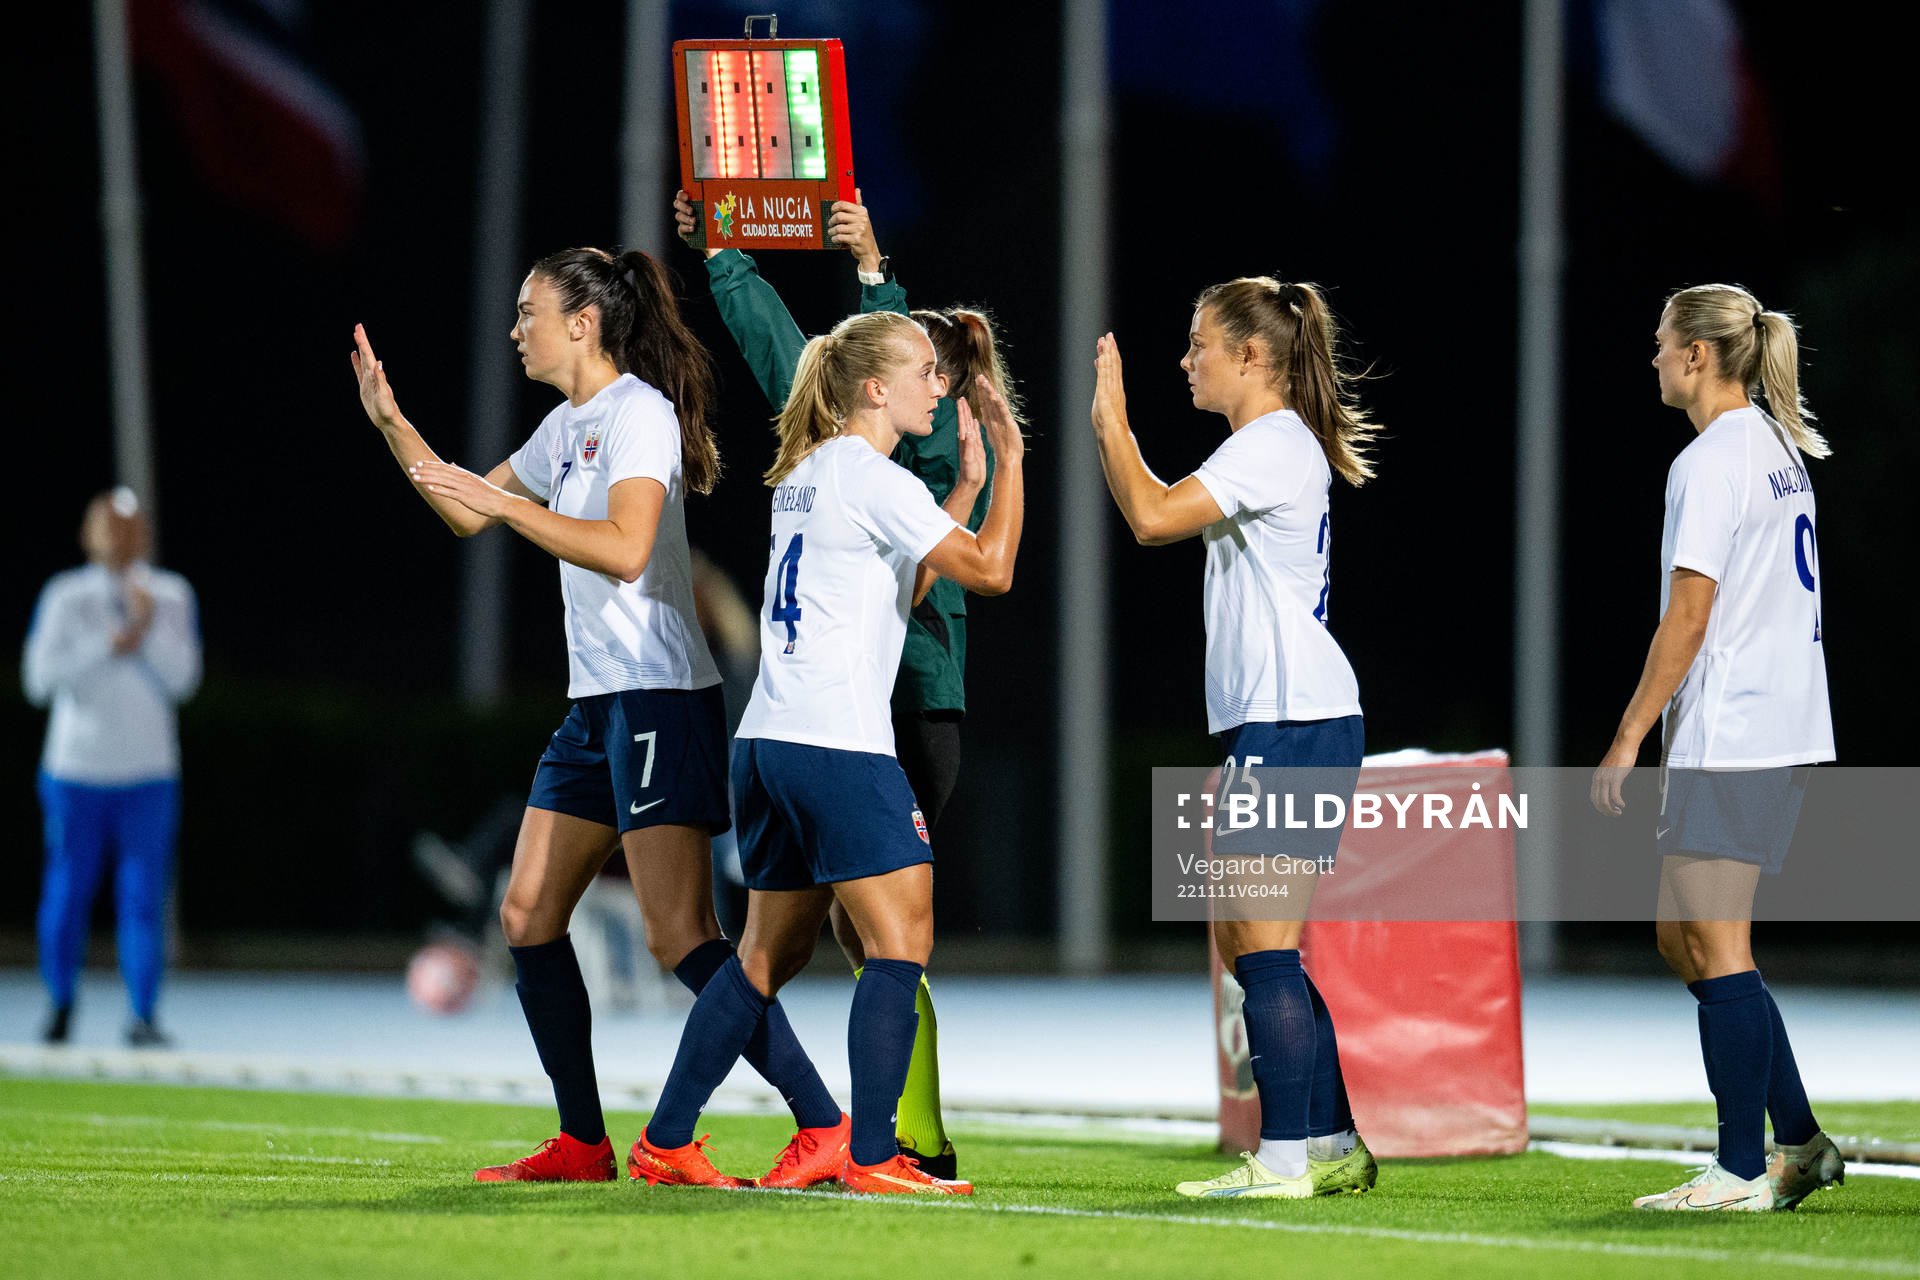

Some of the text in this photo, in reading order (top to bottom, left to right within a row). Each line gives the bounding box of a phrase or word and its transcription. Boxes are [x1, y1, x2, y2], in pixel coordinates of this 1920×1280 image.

[739, 196, 756, 219] LA
[741, 223, 814, 238] CIUDAD DEL DEPORTE
[771, 533, 804, 654] 4
[633, 730, 657, 788] 7
